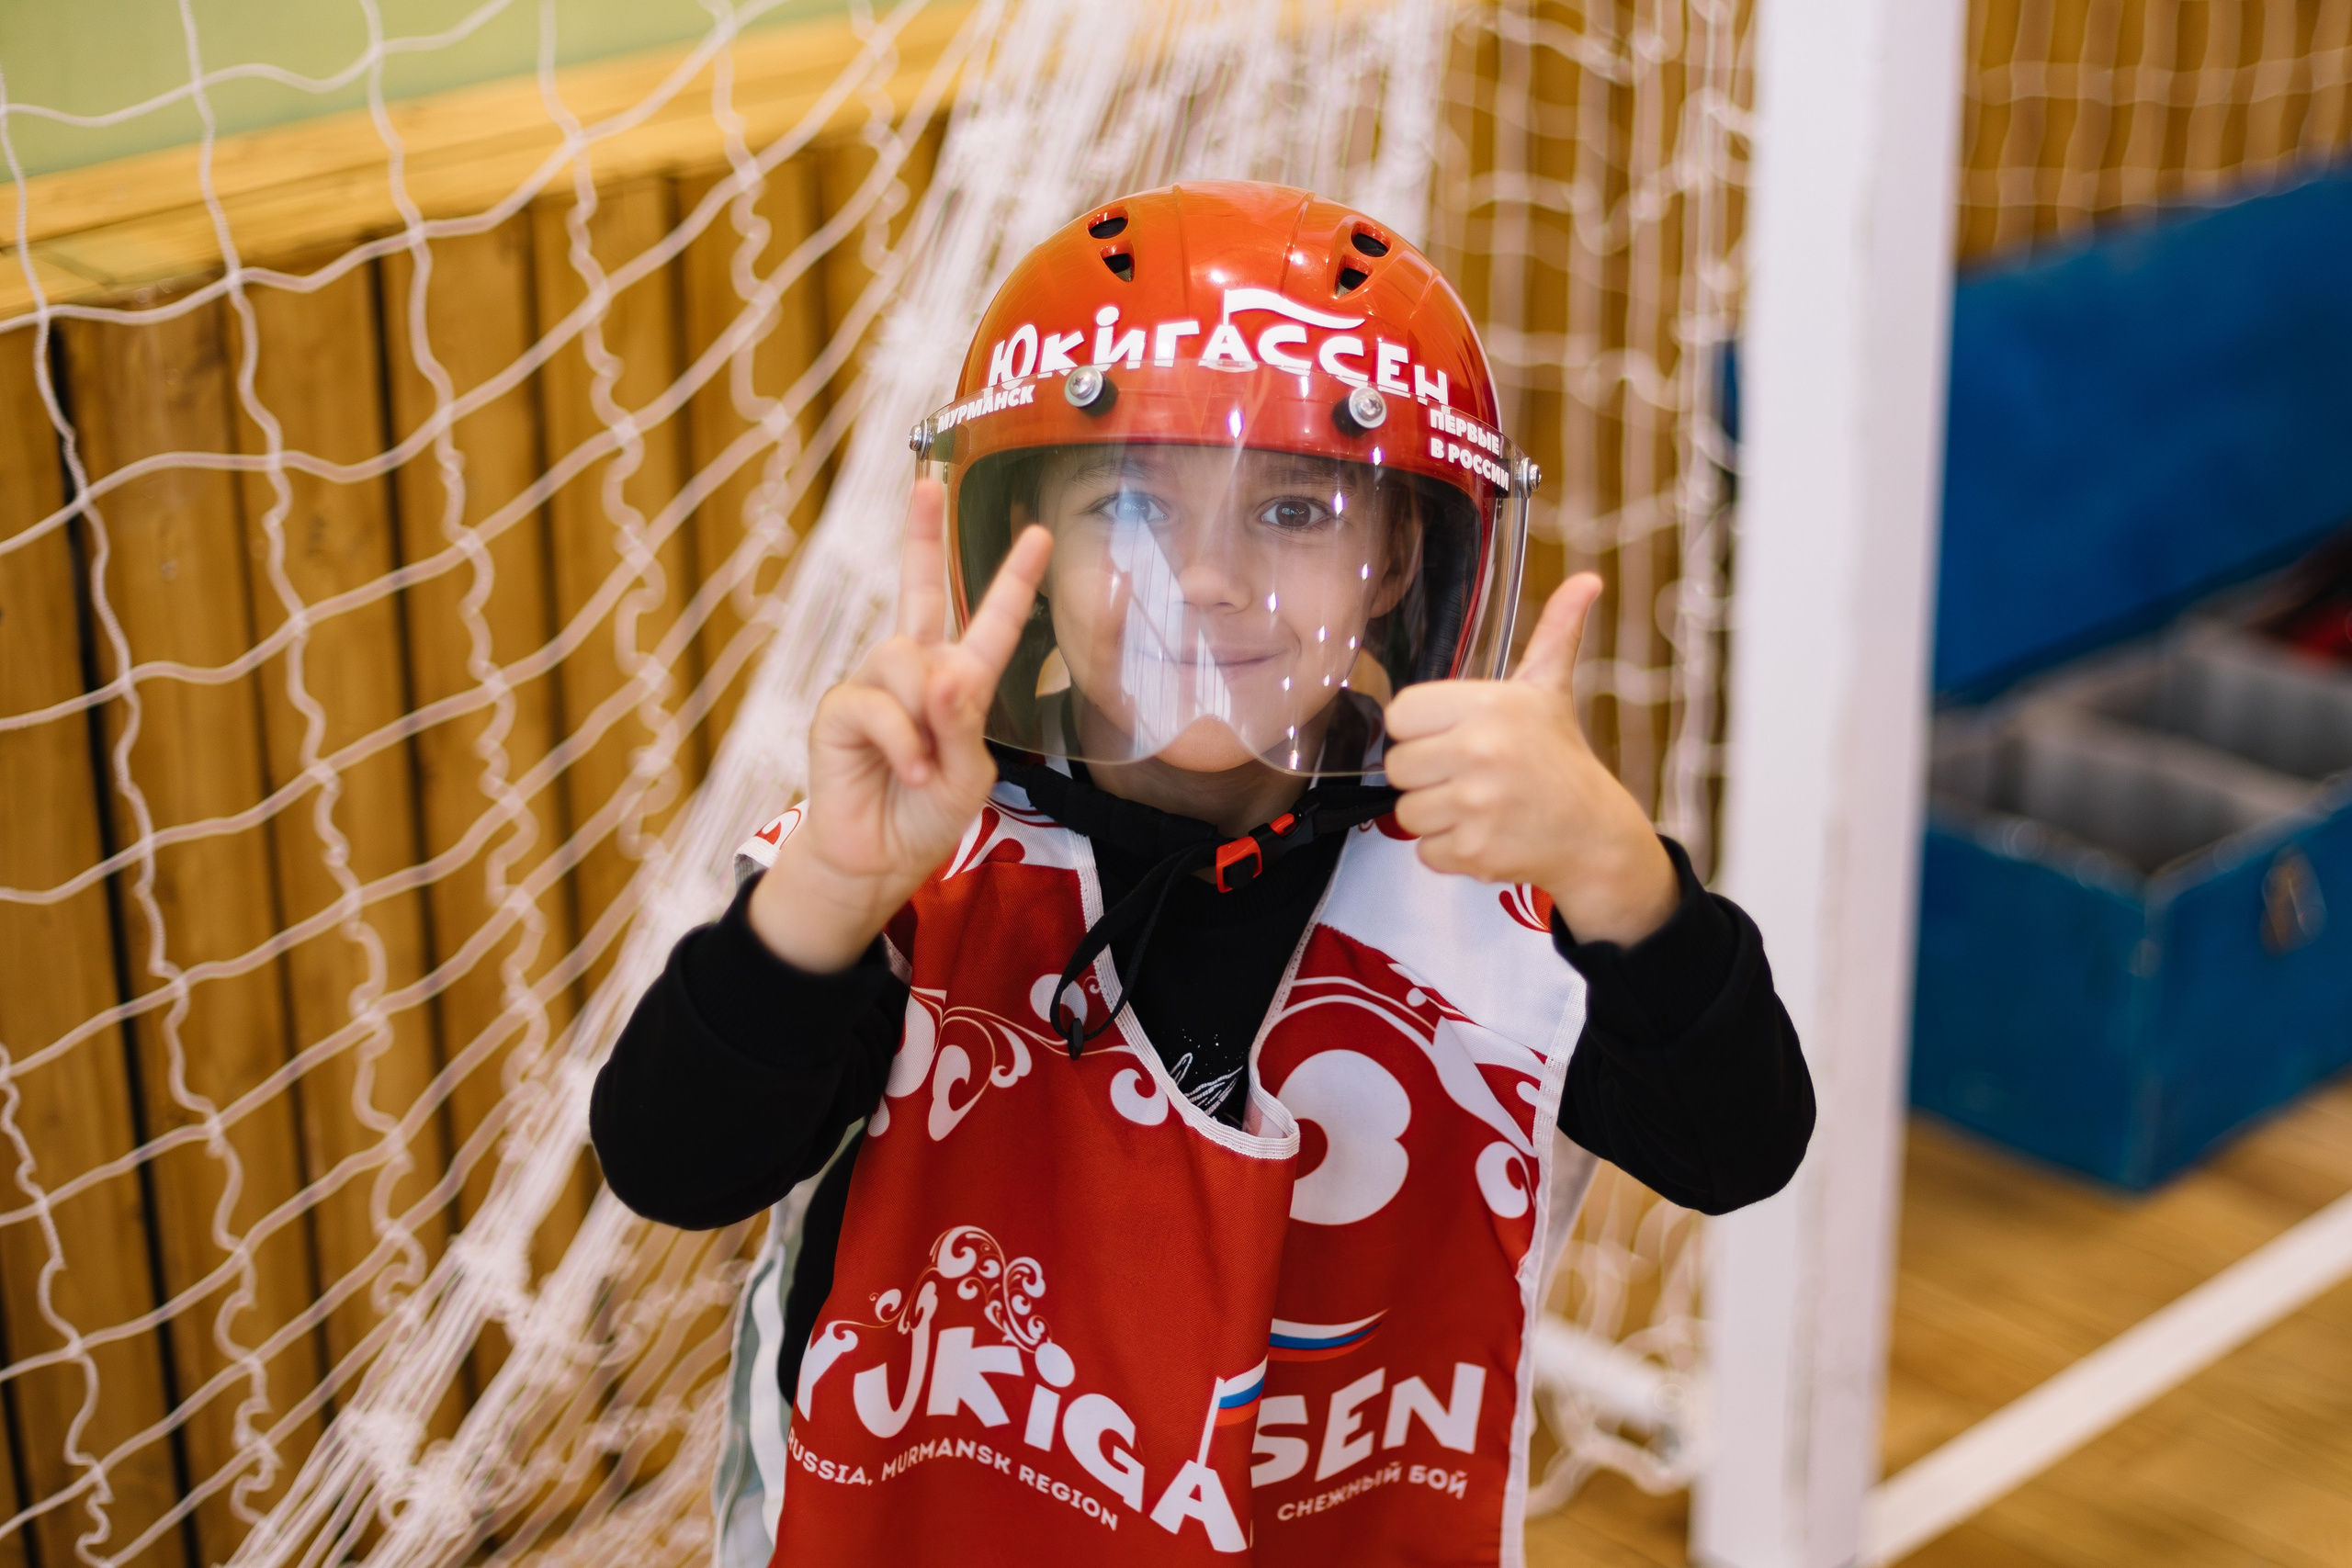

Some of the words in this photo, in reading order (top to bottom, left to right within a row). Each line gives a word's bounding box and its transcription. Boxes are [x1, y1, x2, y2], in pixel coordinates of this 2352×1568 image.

[937, 385, 1035, 434] МУРМАНСК
[1430, 409, 1500, 457] ПЕРВЫЕ
[1430, 437, 1444, 459] В
[1448, 443, 1509, 491] РОССИИ
[786, 1427, 874, 1486] RUSSIA,
[881, 1437, 1012, 1482] MURMANSK
[1018, 1464, 1118, 1531] REGION
[1276, 1461, 1403, 1522] СНЕЖНЫЙ
[1408, 1463, 1469, 1501] БОЙ
